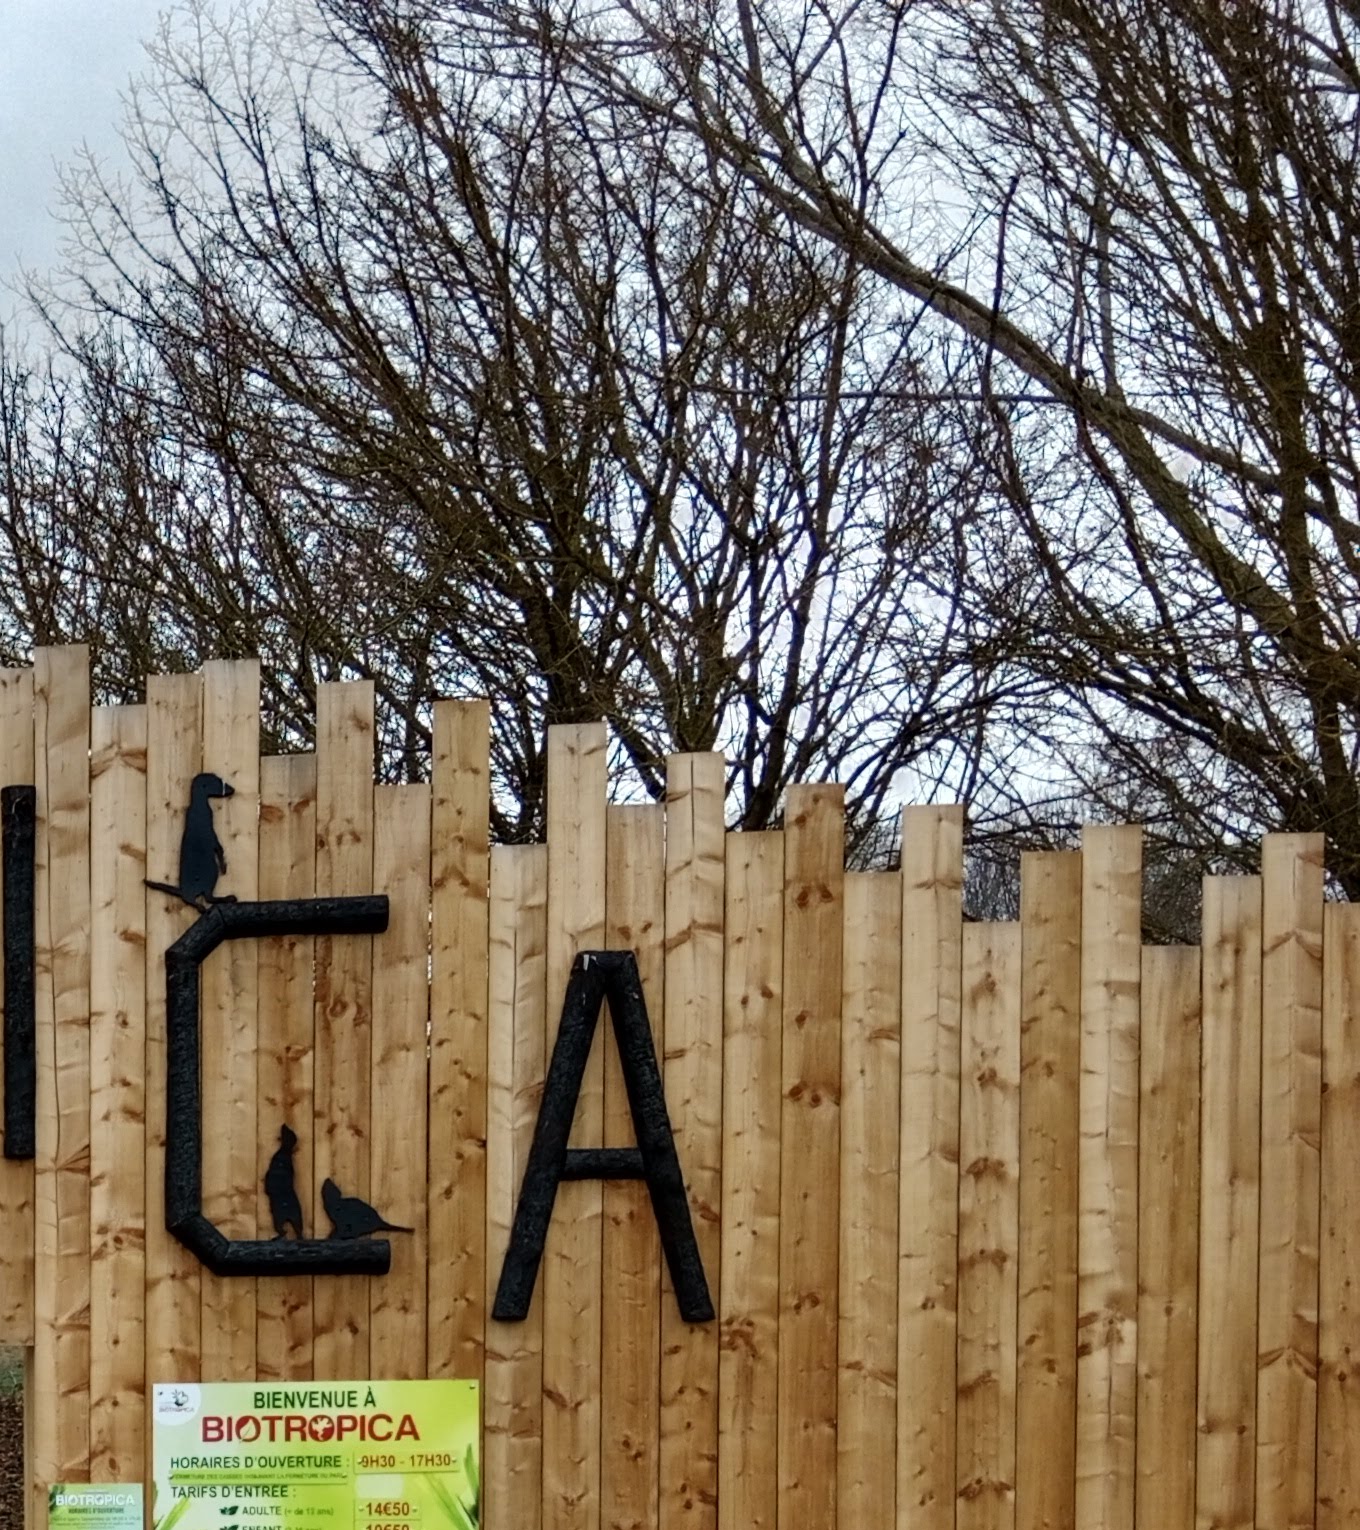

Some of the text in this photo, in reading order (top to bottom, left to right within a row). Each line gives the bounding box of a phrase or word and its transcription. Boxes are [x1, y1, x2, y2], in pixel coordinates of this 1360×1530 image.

[253, 1386, 376, 1409] BIENVENUE À
[201, 1414, 420, 1443] BIOTROPICA
[170, 1456, 240, 1468] HORAIRES
[244, 1455, 342, 1468] D'OUVERTURE
[361, 1454, 395, 1468] 9H30
[409, 1454, 451, 1467] 17H30
[172, 1486, 217, 1499] TARIFS
[55, 1494, 135, 1506] BIOTROPICA
[242, 1506, 282, 1515] ADULTE
[366, 1502, 410, 1516] 14€50
